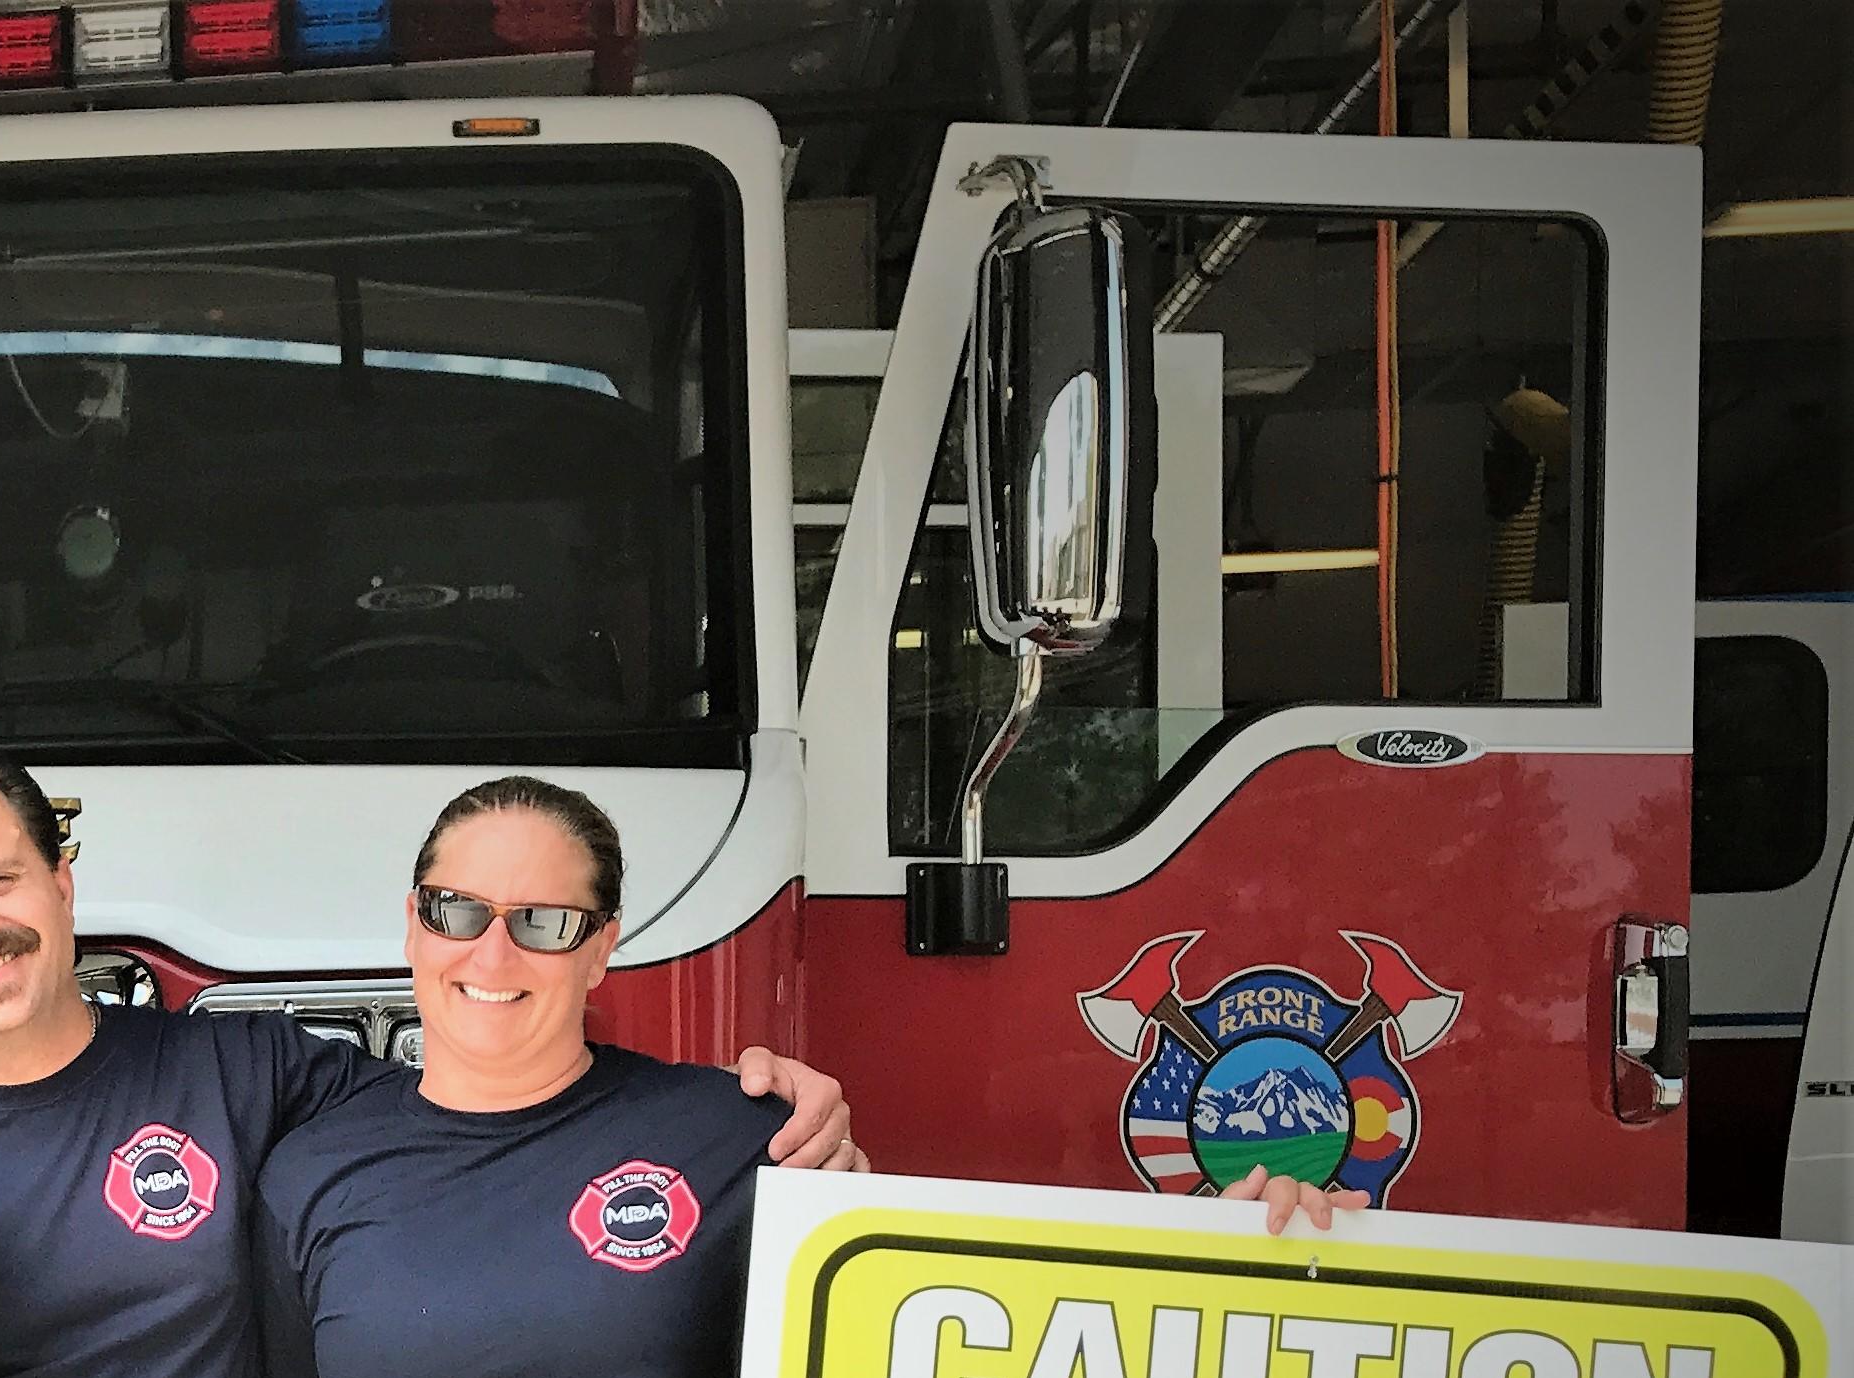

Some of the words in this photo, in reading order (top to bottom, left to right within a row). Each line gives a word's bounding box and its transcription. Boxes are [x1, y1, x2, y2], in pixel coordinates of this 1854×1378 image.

[1376, 732, 1453, 762] Velocity
[1218, 987, 1325, 1018] FRONT
[1217, 1007, 1325, 1039] RANGE
[1807, 1083, 1854, 1097] SL
[135, 1169, 188, 1194] MDA
[145, 1213, 176, 1226] SINCE
[606, 1202, 668, 1225] MDA
[606, 1242, 640, 1257] SINCE
